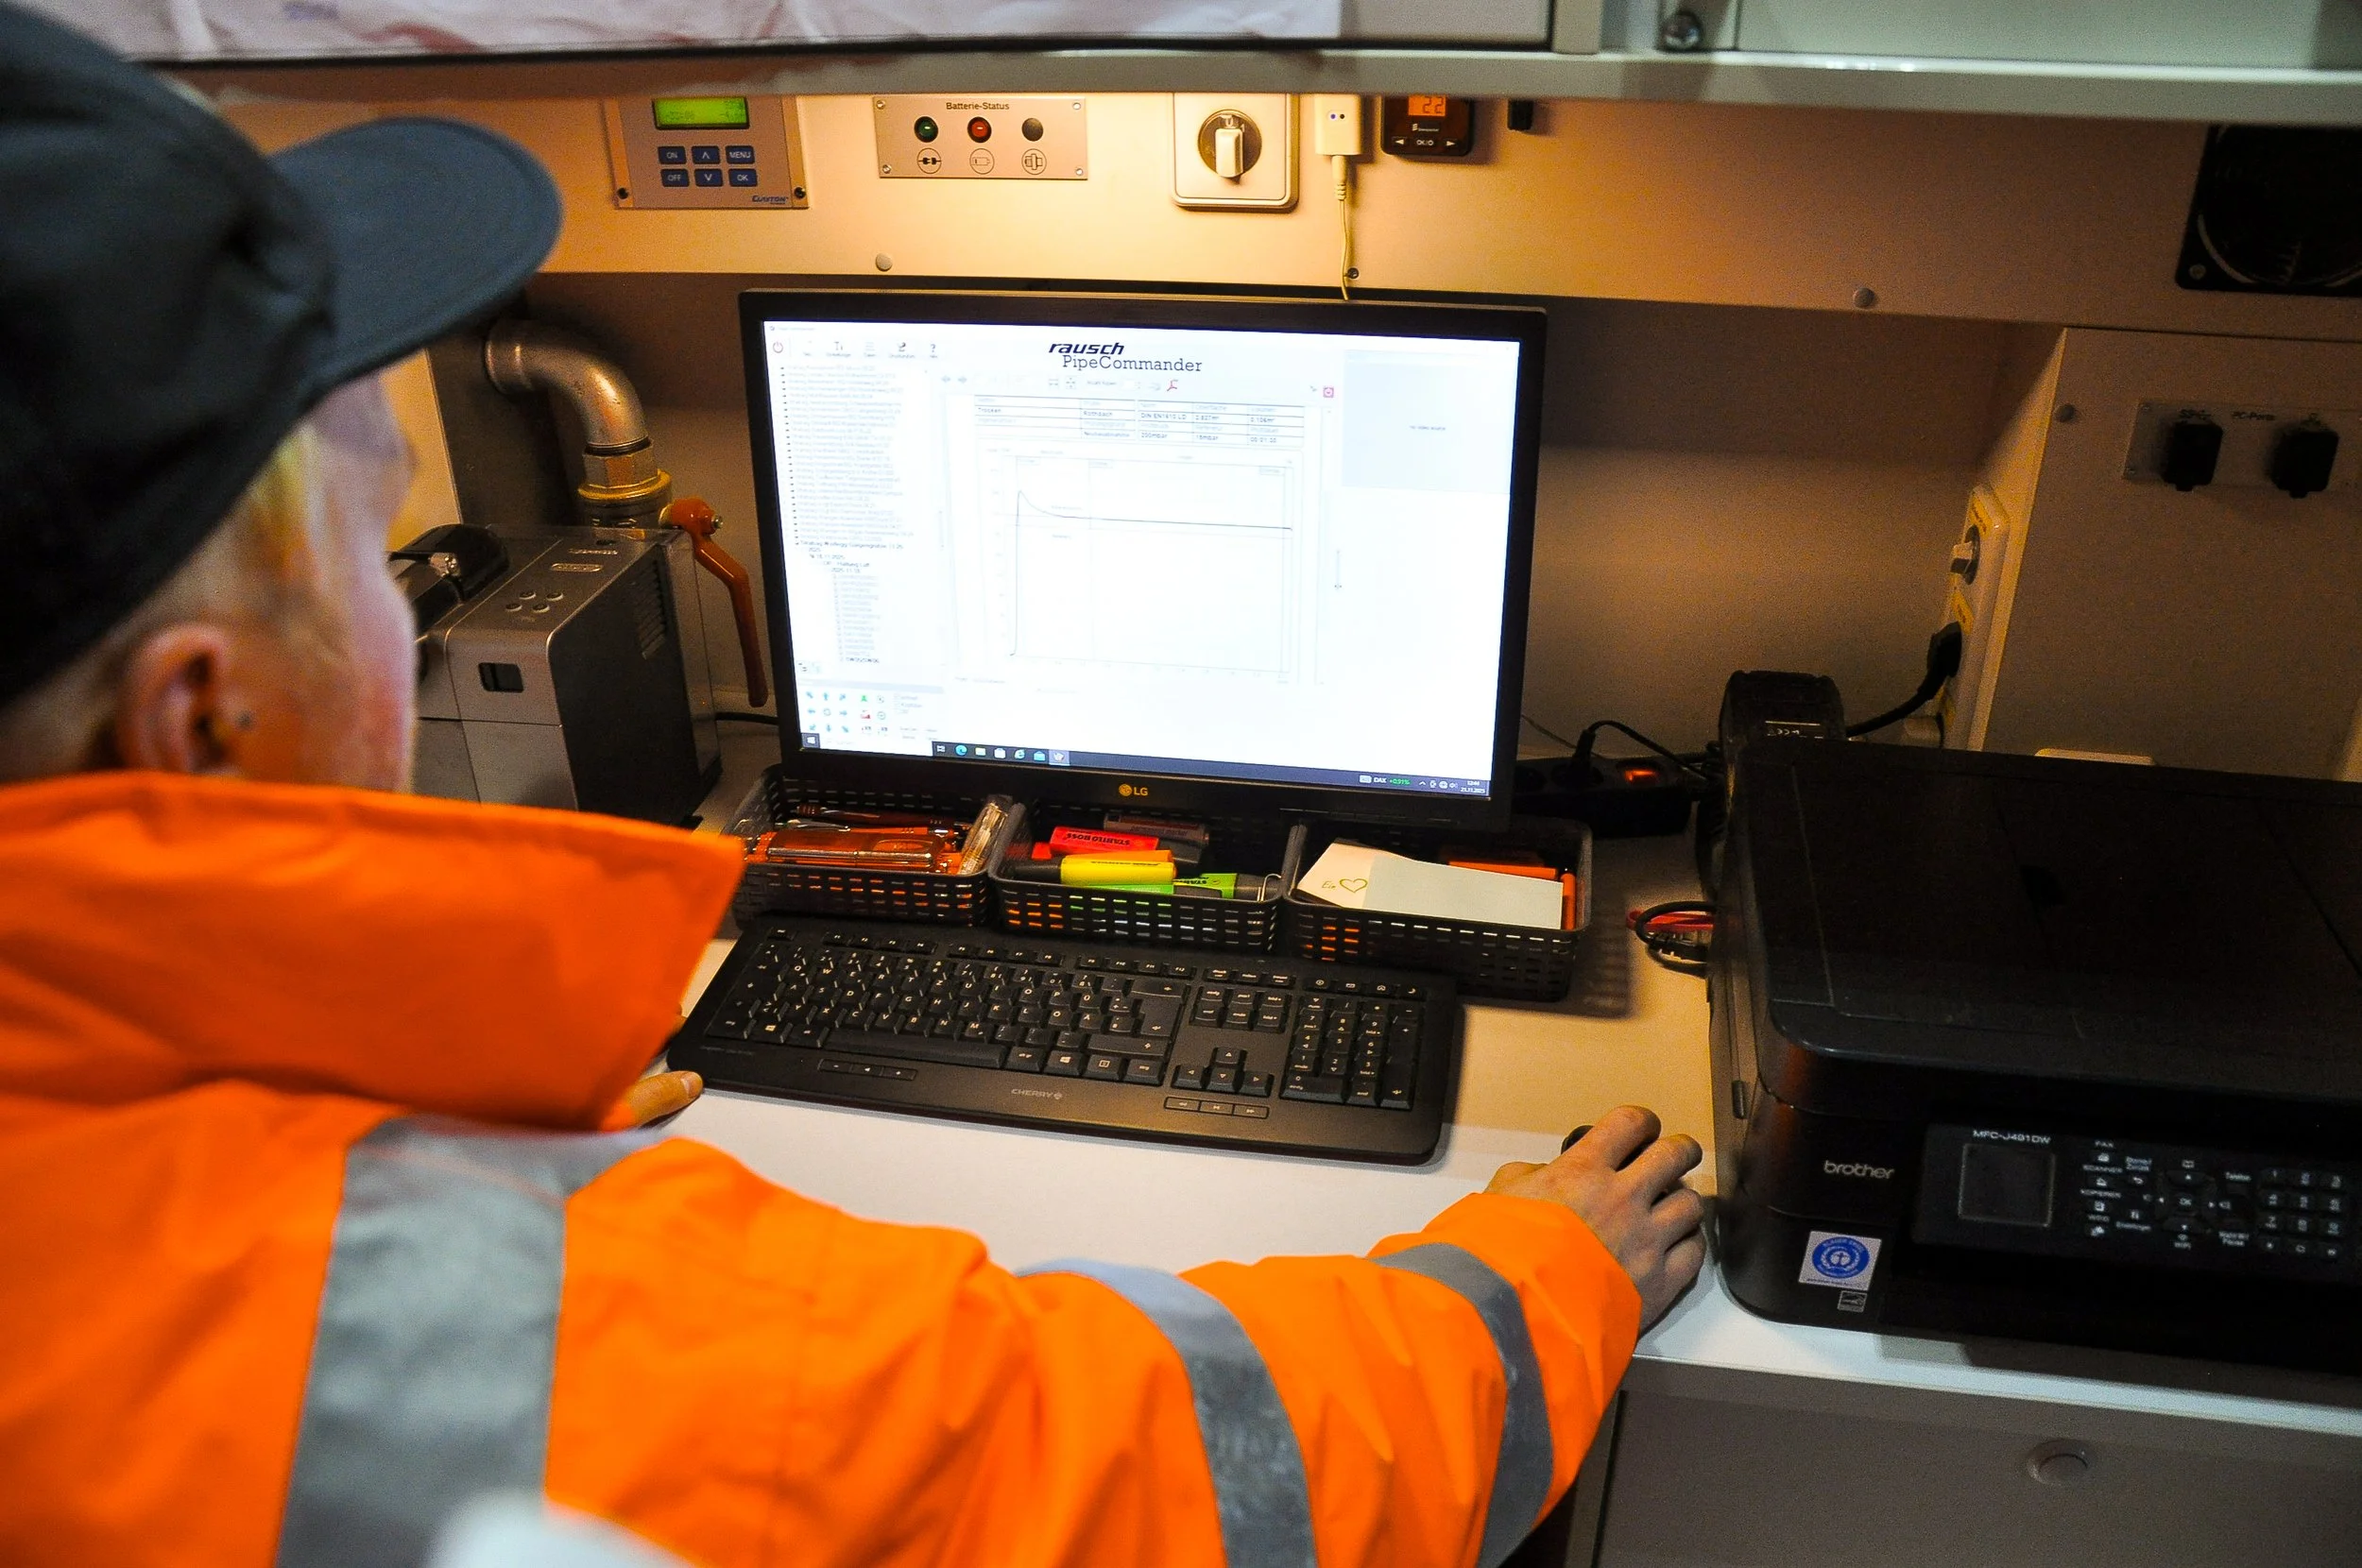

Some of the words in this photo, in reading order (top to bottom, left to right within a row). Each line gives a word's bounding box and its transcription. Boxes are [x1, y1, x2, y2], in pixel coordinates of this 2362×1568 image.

[946, 102, 1010, 111] Batterie-Status
[1049, 342, 1125, 355] rausch
[1062, 355, 1203, 371] PipeCommander
[1134, 787, 1149, 796] LG
[1066, 832, 1091, 841] BOSS
[1091, 837, 1131, 845] STABILO
[1011, 1088, 1054, 1098] CHERRY
[1823, 1160, 1895, 1180] brother
